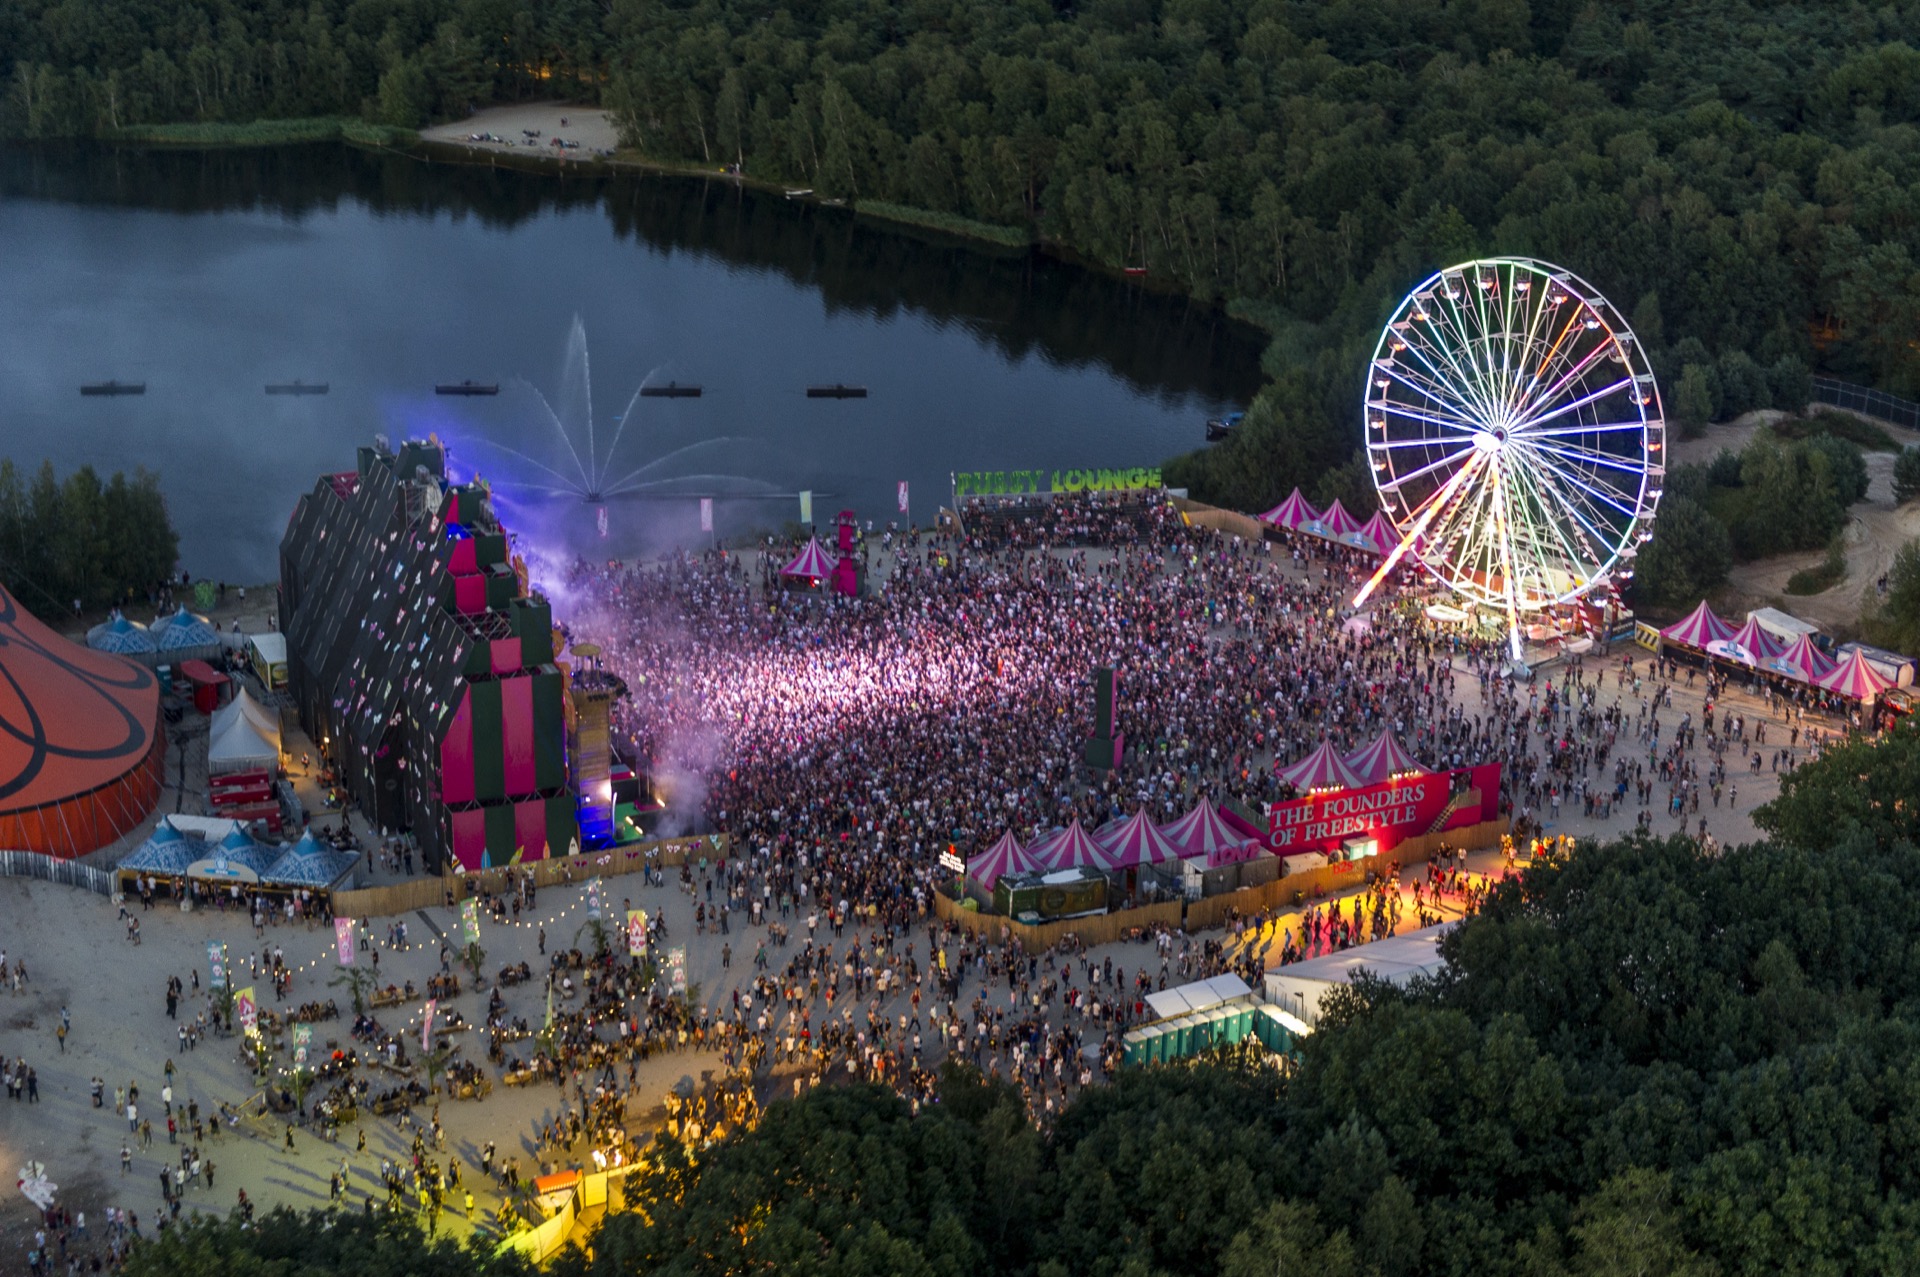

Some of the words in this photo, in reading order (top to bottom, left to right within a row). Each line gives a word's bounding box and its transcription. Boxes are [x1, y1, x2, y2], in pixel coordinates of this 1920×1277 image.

[957, 471, 1043, 495] PUSSY
[1052, 468, 1161, 492] LOUNGE
[1272, 804, 1314, 828] THE
[1322, 784, 1425, 818] FOUNDERS
[1270, 829, 1296, 847] OF
[1304, 806, 1416, 842] FREESTYLE
[1207, 839, 1260, 867] LOVE
